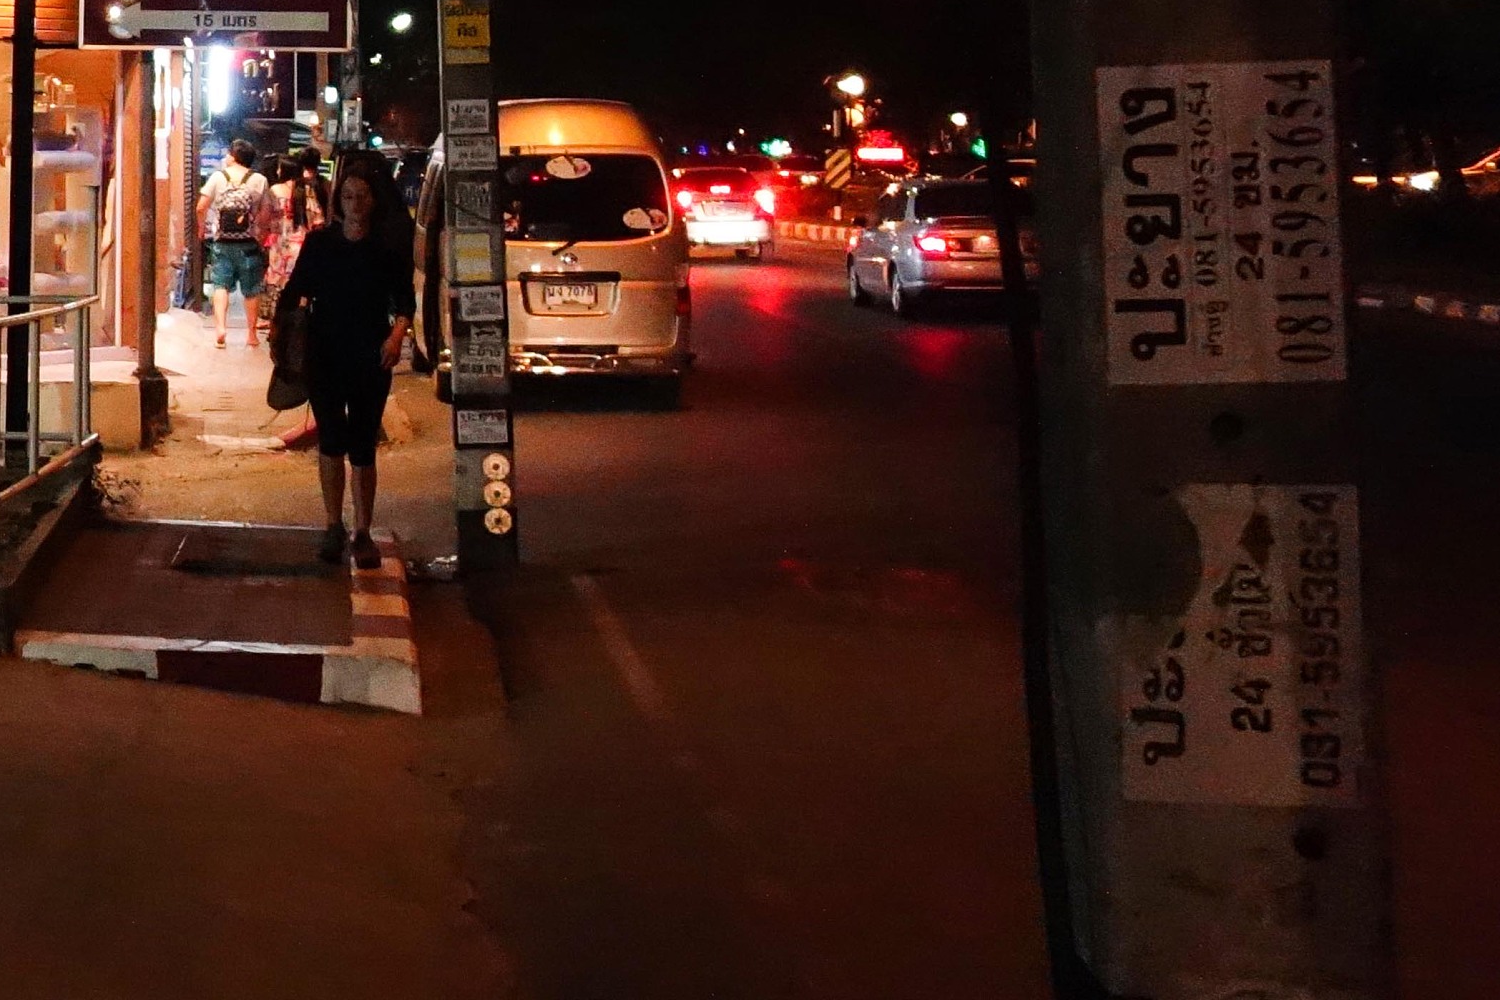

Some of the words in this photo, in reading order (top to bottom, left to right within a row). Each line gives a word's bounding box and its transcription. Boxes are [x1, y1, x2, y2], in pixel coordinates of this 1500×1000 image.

[193, 14, 213, 27] 15
[222, 14, 257, 27] เมตร
[1115, 87, 1187, 361] ปะยาง
[1264, 69, 1333, 363] 081-5953654
[1234, 231, 1265, 282] 24
[1230, 679, 1272, 733] 24
